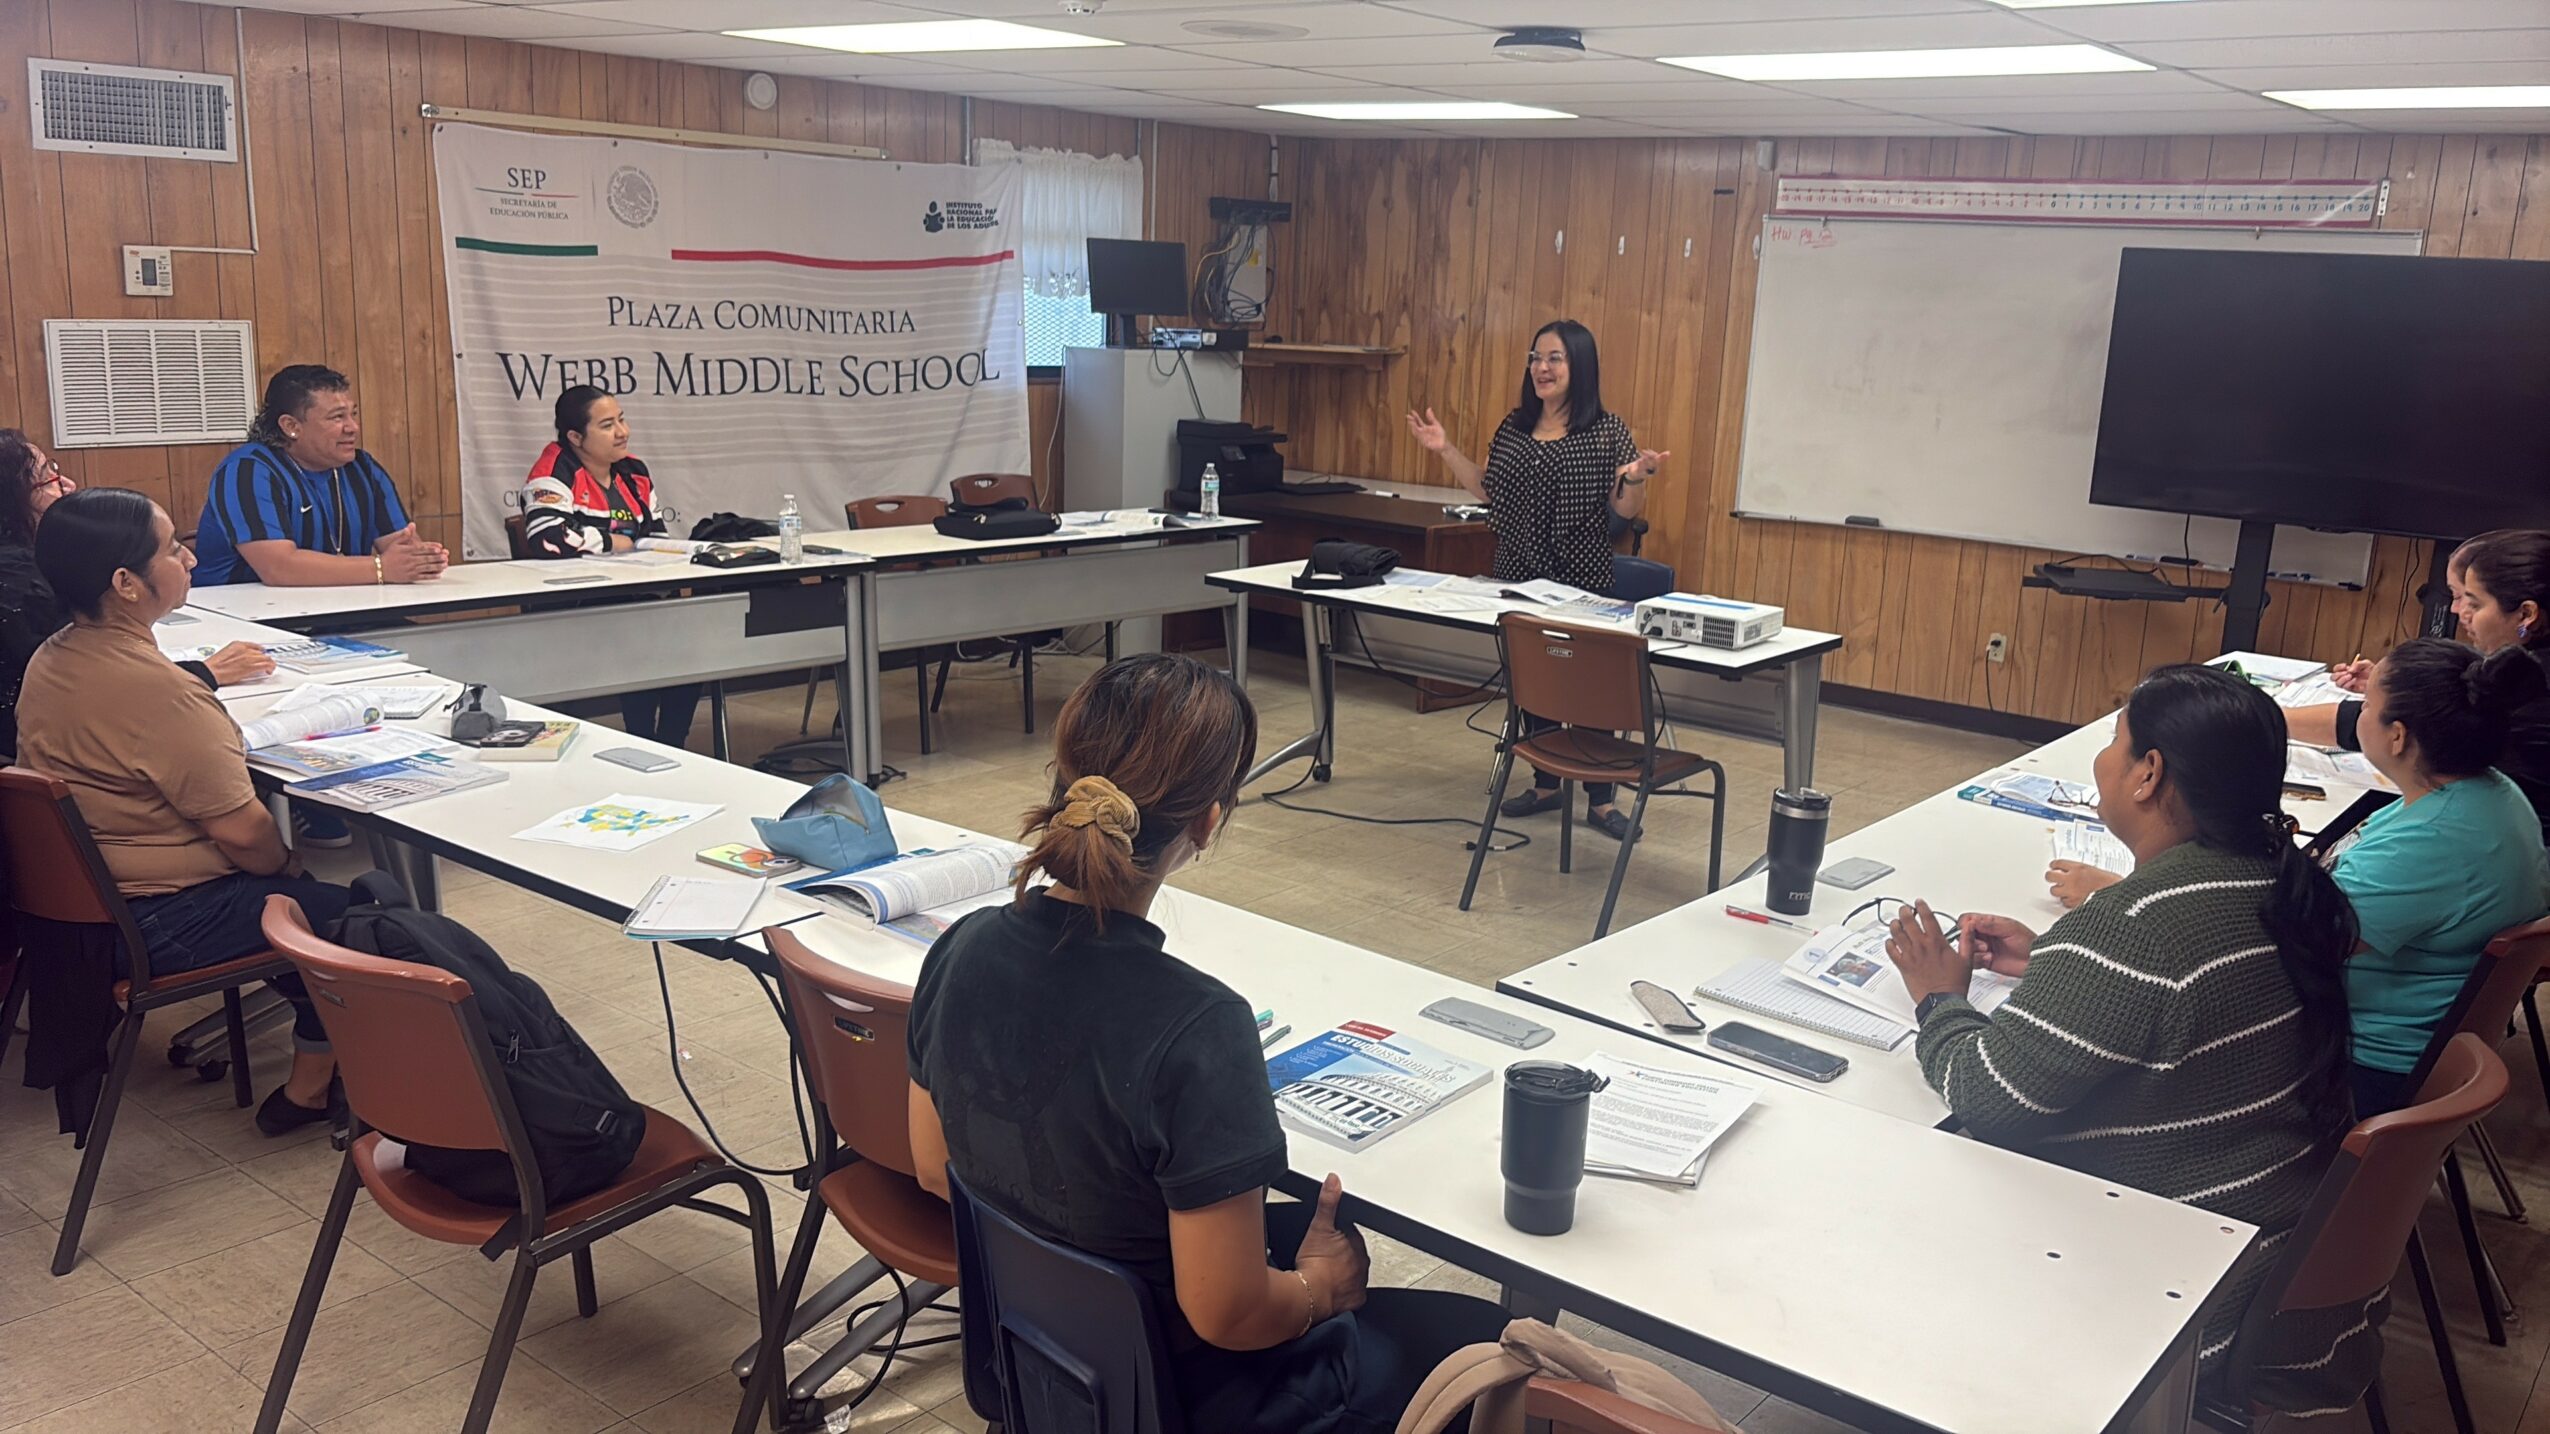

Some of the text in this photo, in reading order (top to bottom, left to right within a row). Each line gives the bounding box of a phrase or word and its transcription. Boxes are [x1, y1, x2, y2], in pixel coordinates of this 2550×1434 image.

[508, 167, 546, 189] SEP
[500, 197, 545, 208] SECRETARÍA
[2290, 204, 2300, 212] 16
[2307, 204, 2317, 212] 17
[2358, 204, 2370, 212] 20
[489, 208, 569, 220] EDUCACIÓN PÚBLICA
[606, 296, 916, 335] PLAZA COMUNITARIA
[495, 349, 1001, 401] WEBB MIDDLE SCHOOL
[1330, 1034, 1393, 1060] ESTUDIOS
